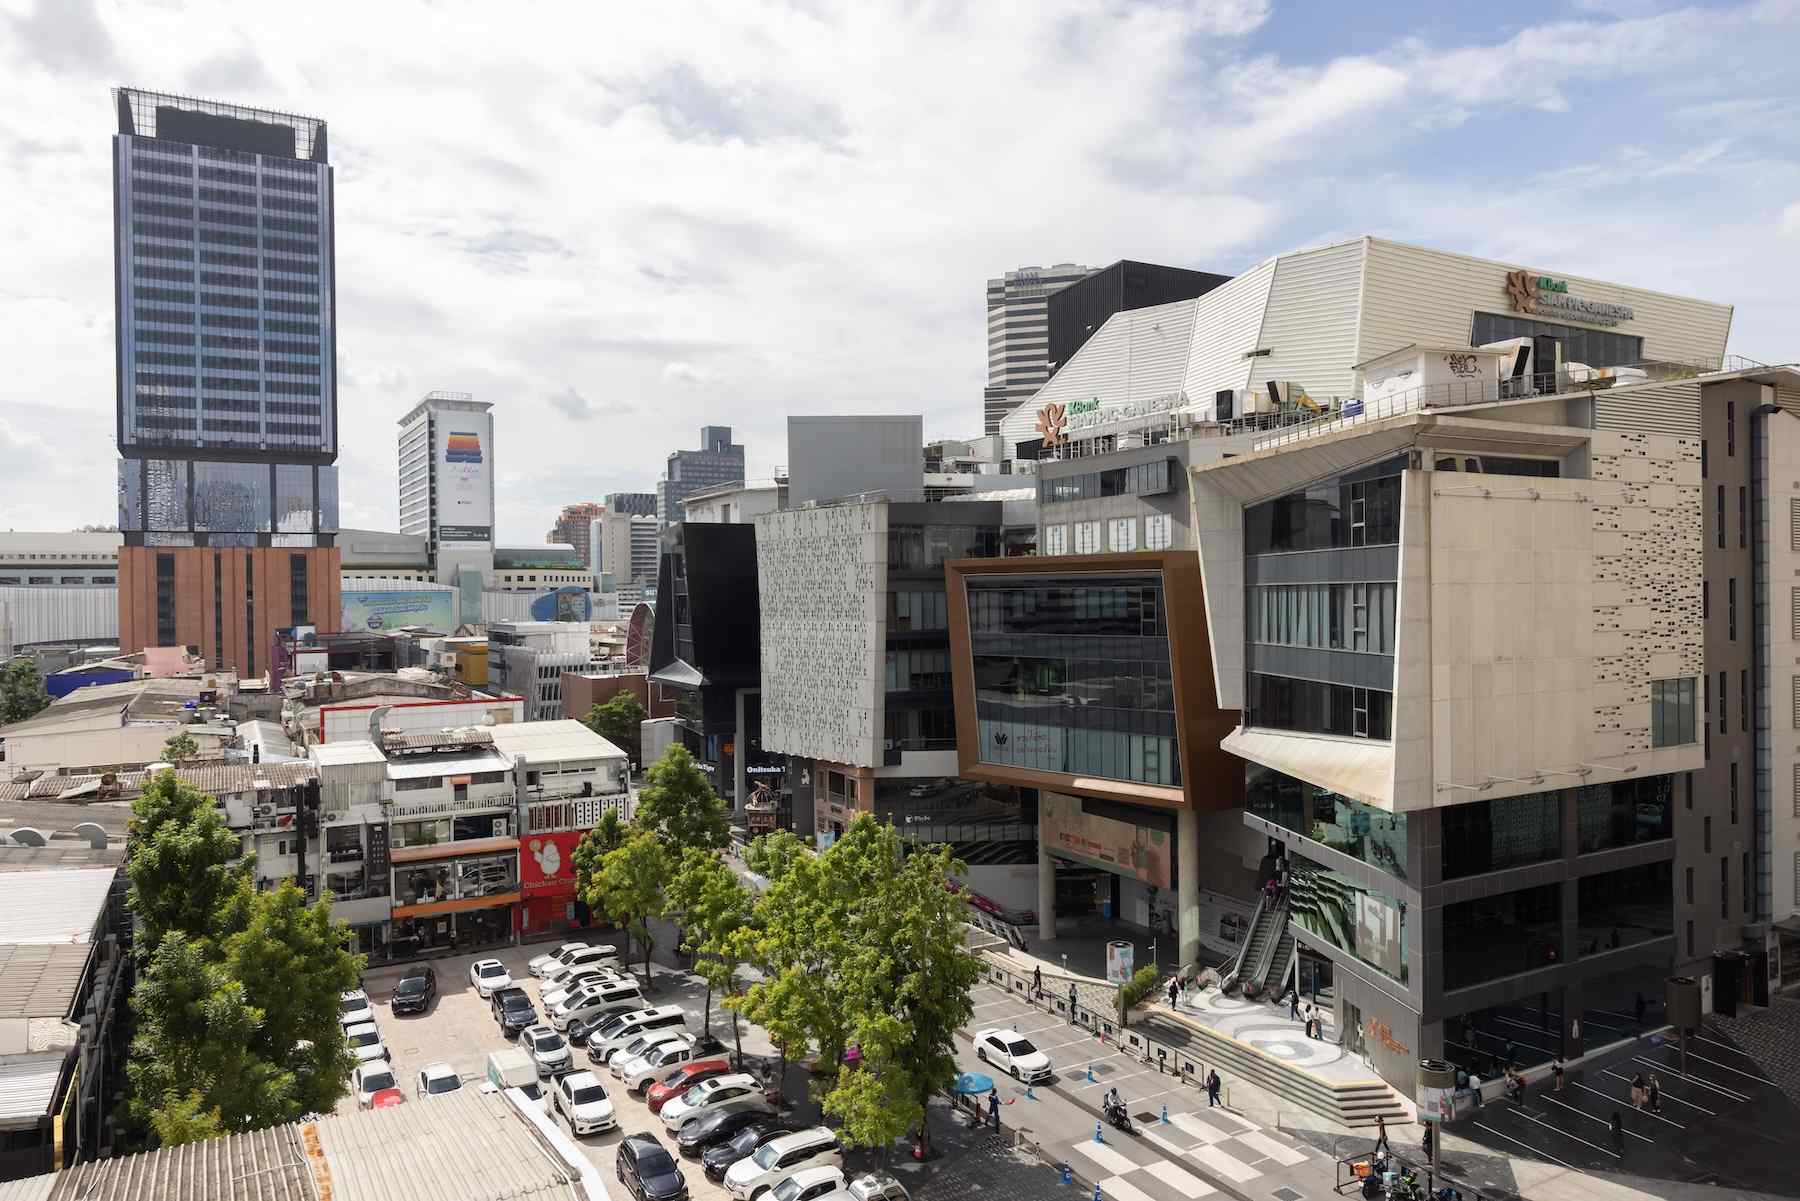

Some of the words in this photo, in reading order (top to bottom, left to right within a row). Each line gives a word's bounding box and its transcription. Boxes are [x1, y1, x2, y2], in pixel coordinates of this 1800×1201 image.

[1537, 276, 1568, 293] KBank
[1067, 397, 1100, 415] KBank
[747, 766, 781, 774] Onitsuka
